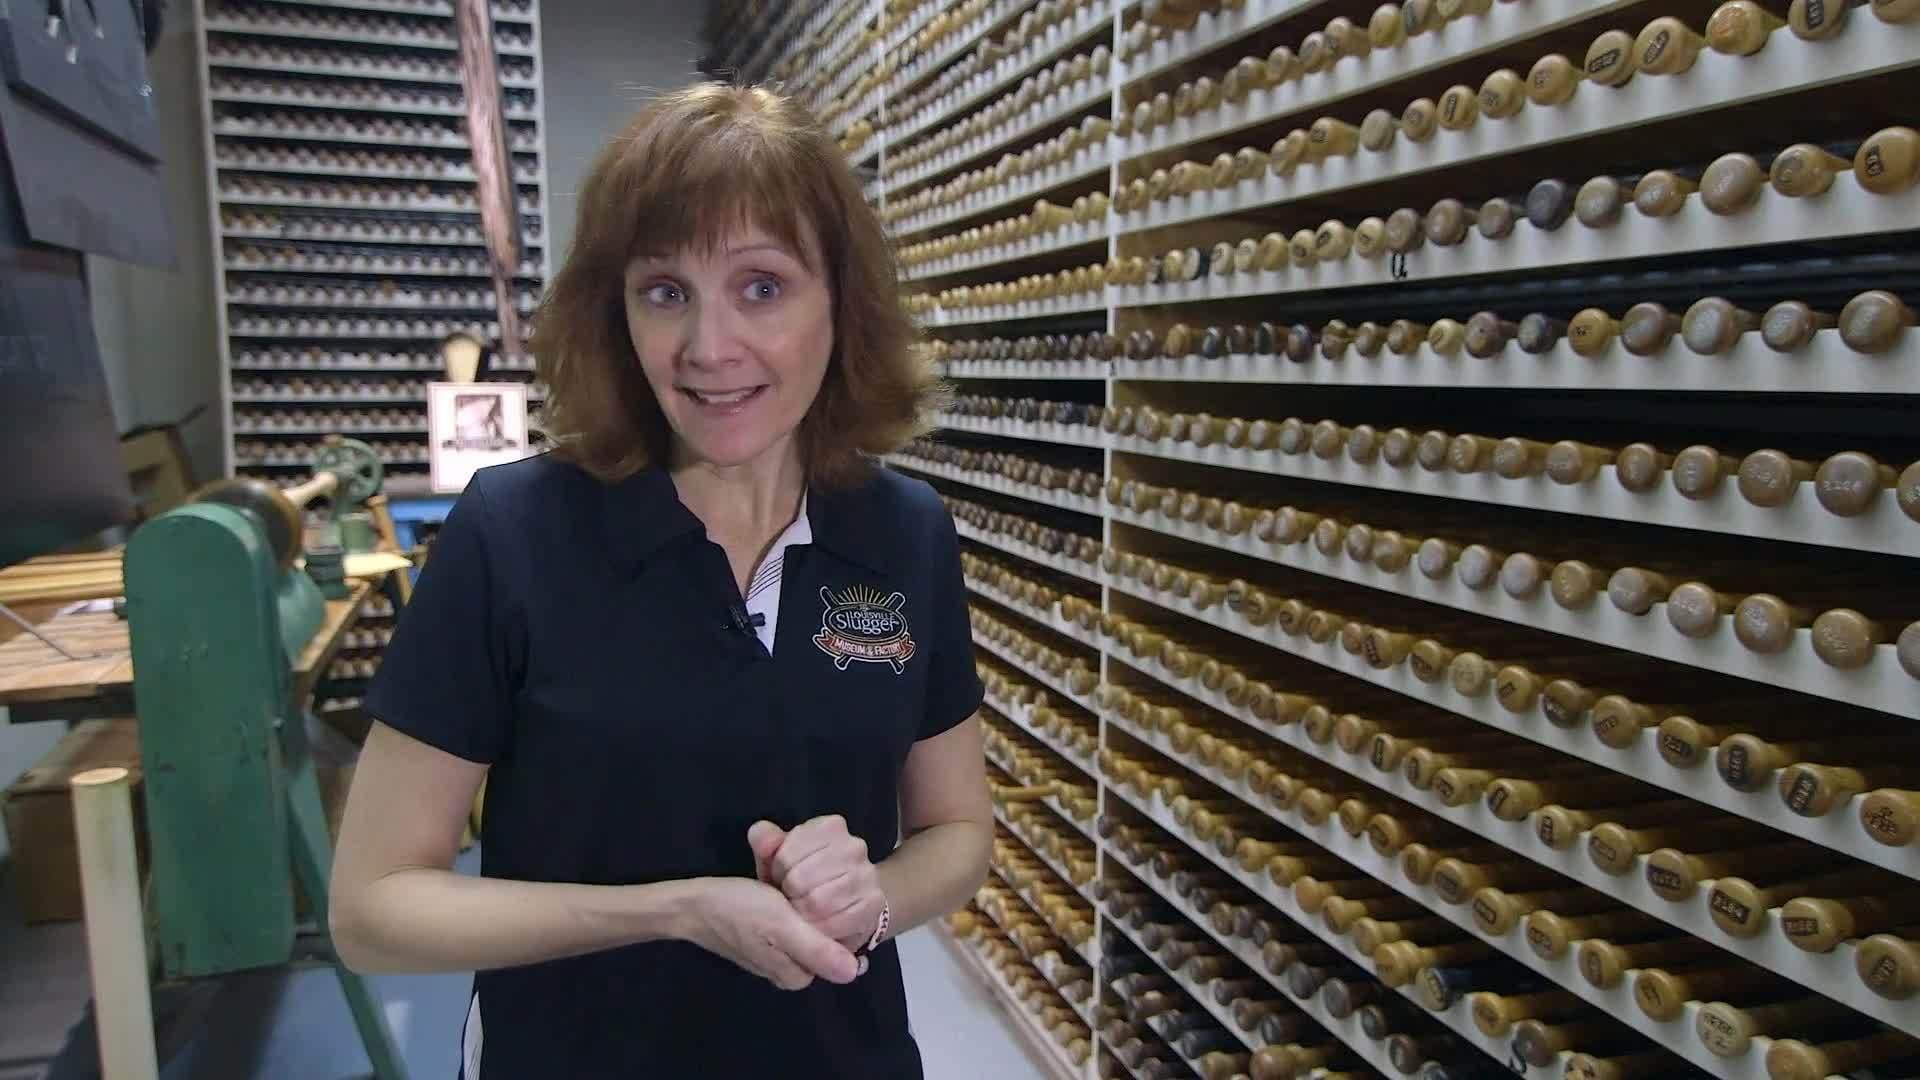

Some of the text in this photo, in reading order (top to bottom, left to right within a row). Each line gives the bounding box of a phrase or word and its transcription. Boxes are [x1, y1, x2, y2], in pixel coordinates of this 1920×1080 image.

[836, 611, 900, 635] Slugger
[850, 610, 895, 621] LOUISVILLE
[834, 638, 866, 655] MUSEUM
[875, 641, 902, 656] FACTORY
